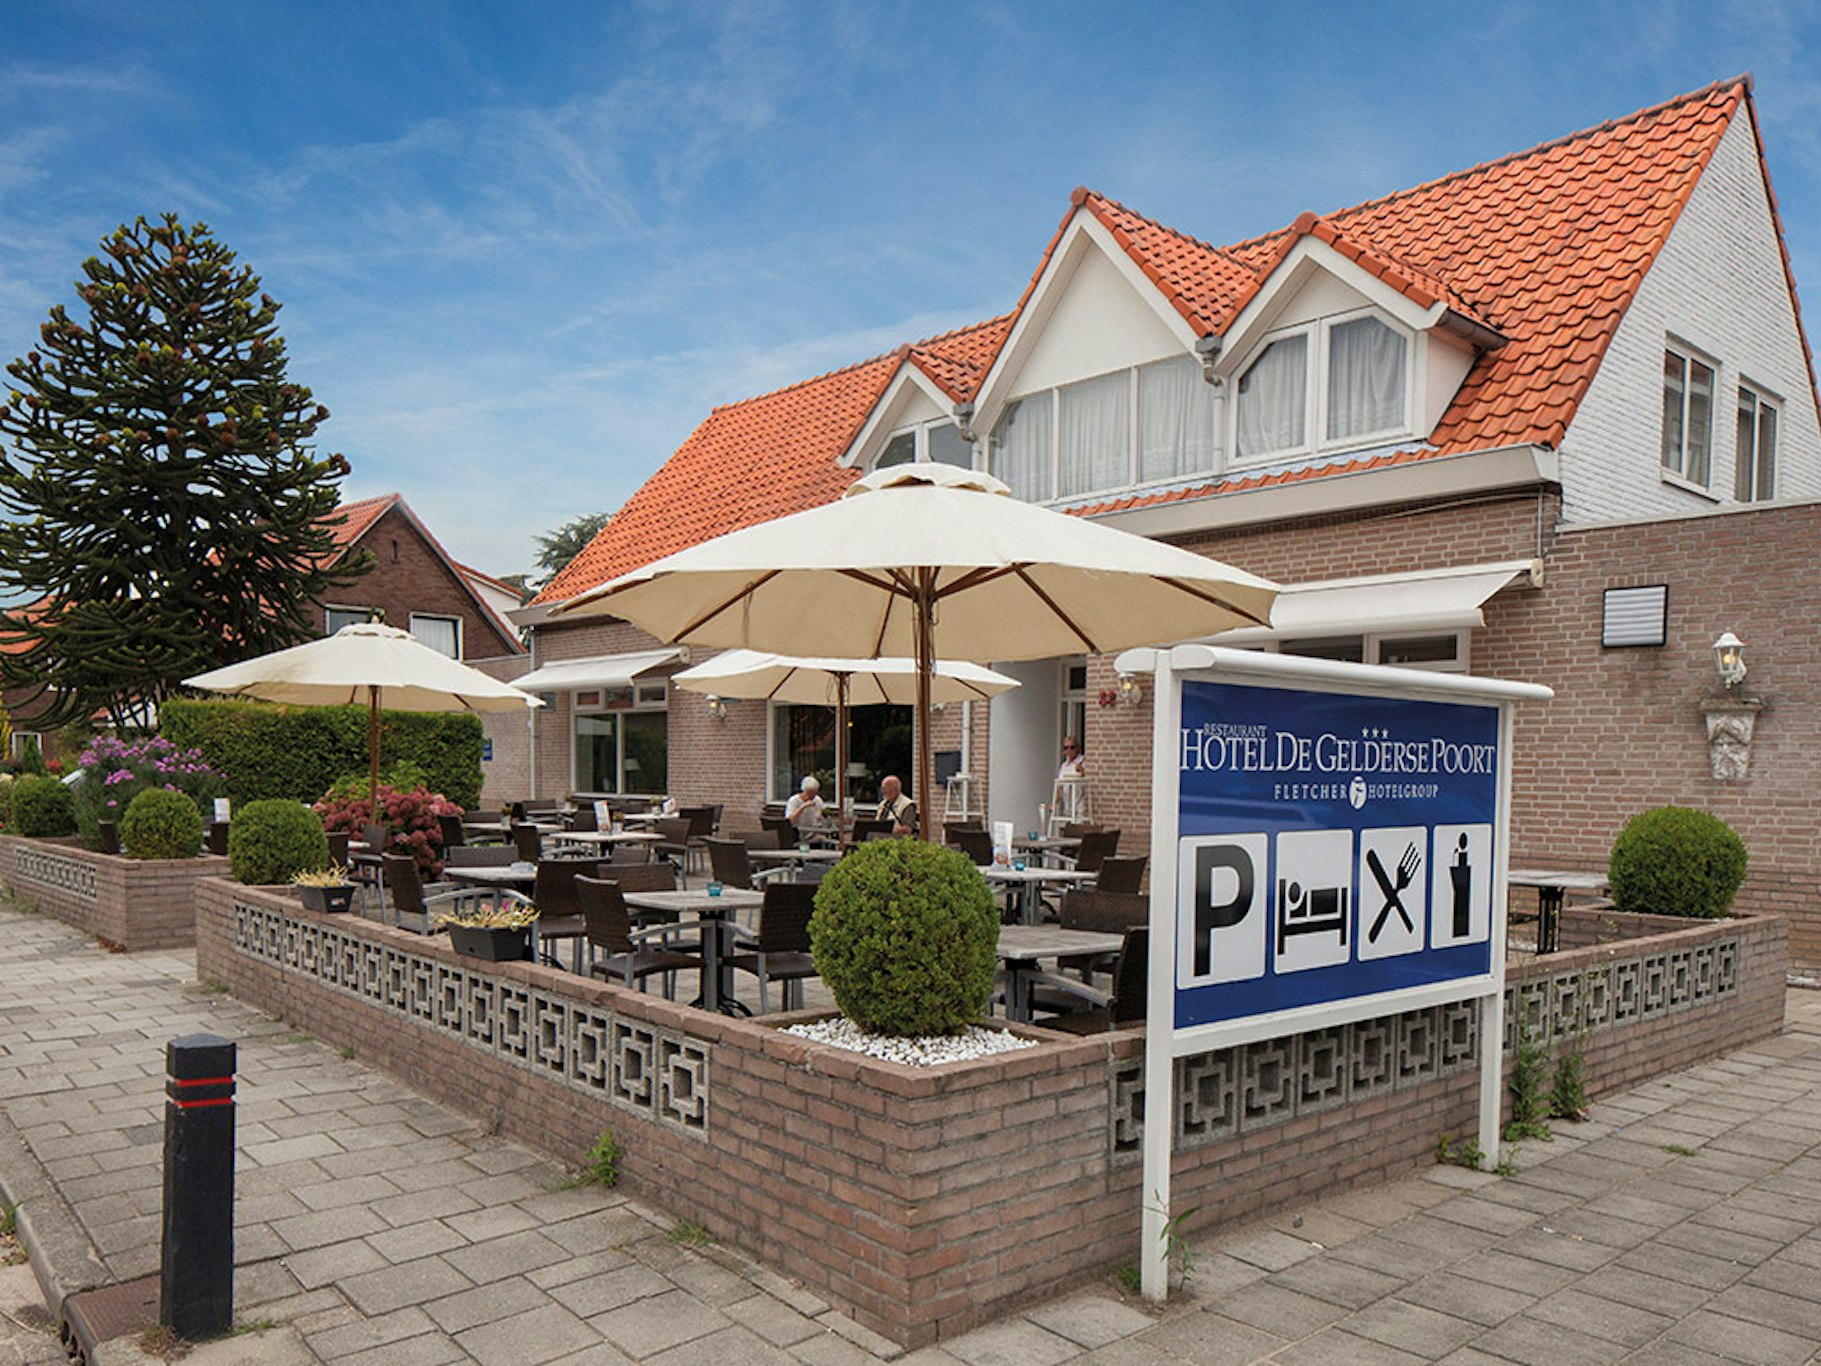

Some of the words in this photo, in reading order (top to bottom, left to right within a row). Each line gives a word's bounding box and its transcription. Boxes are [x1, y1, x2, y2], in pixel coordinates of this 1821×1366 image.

[1203, 723, 1268, 737] RESTAURANT
[1180, 728, 1275, 771] HOTEL
[1315, 733, 1430, 773] GELDERSE
[1431, 738, 1496, 774] POORT
[1274, 783, 1348, 800] FLETCHER
[1368, 783, 1439, 800] HOTELGROUP
[1193, 844, 1255, 977] P
